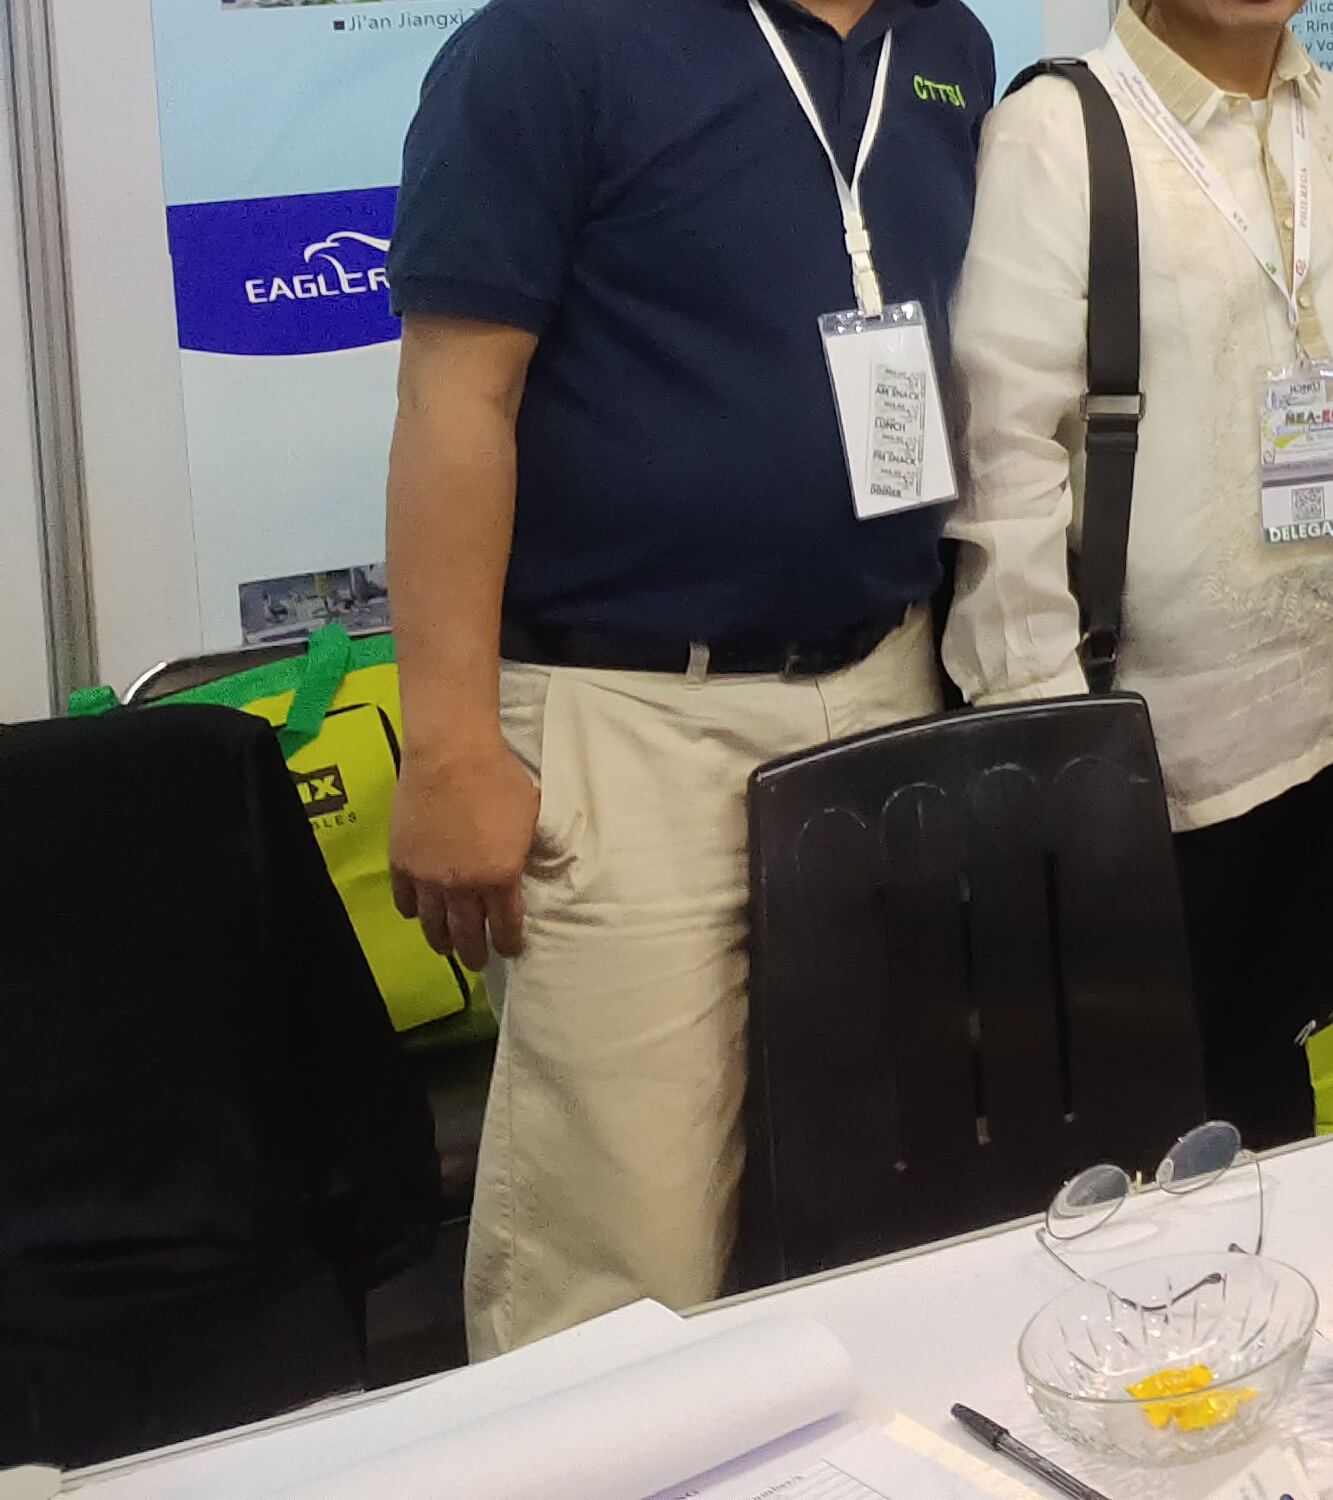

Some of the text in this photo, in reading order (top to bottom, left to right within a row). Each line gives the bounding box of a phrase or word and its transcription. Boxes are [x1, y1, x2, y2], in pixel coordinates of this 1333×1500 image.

[349, 10, 464, 32] Ji'an Jiangxi
[1319, 60, 1333, 72] ry
[245, 268, 391, 304] EAGLER
[875, 416, 906, 432] LUNCH
